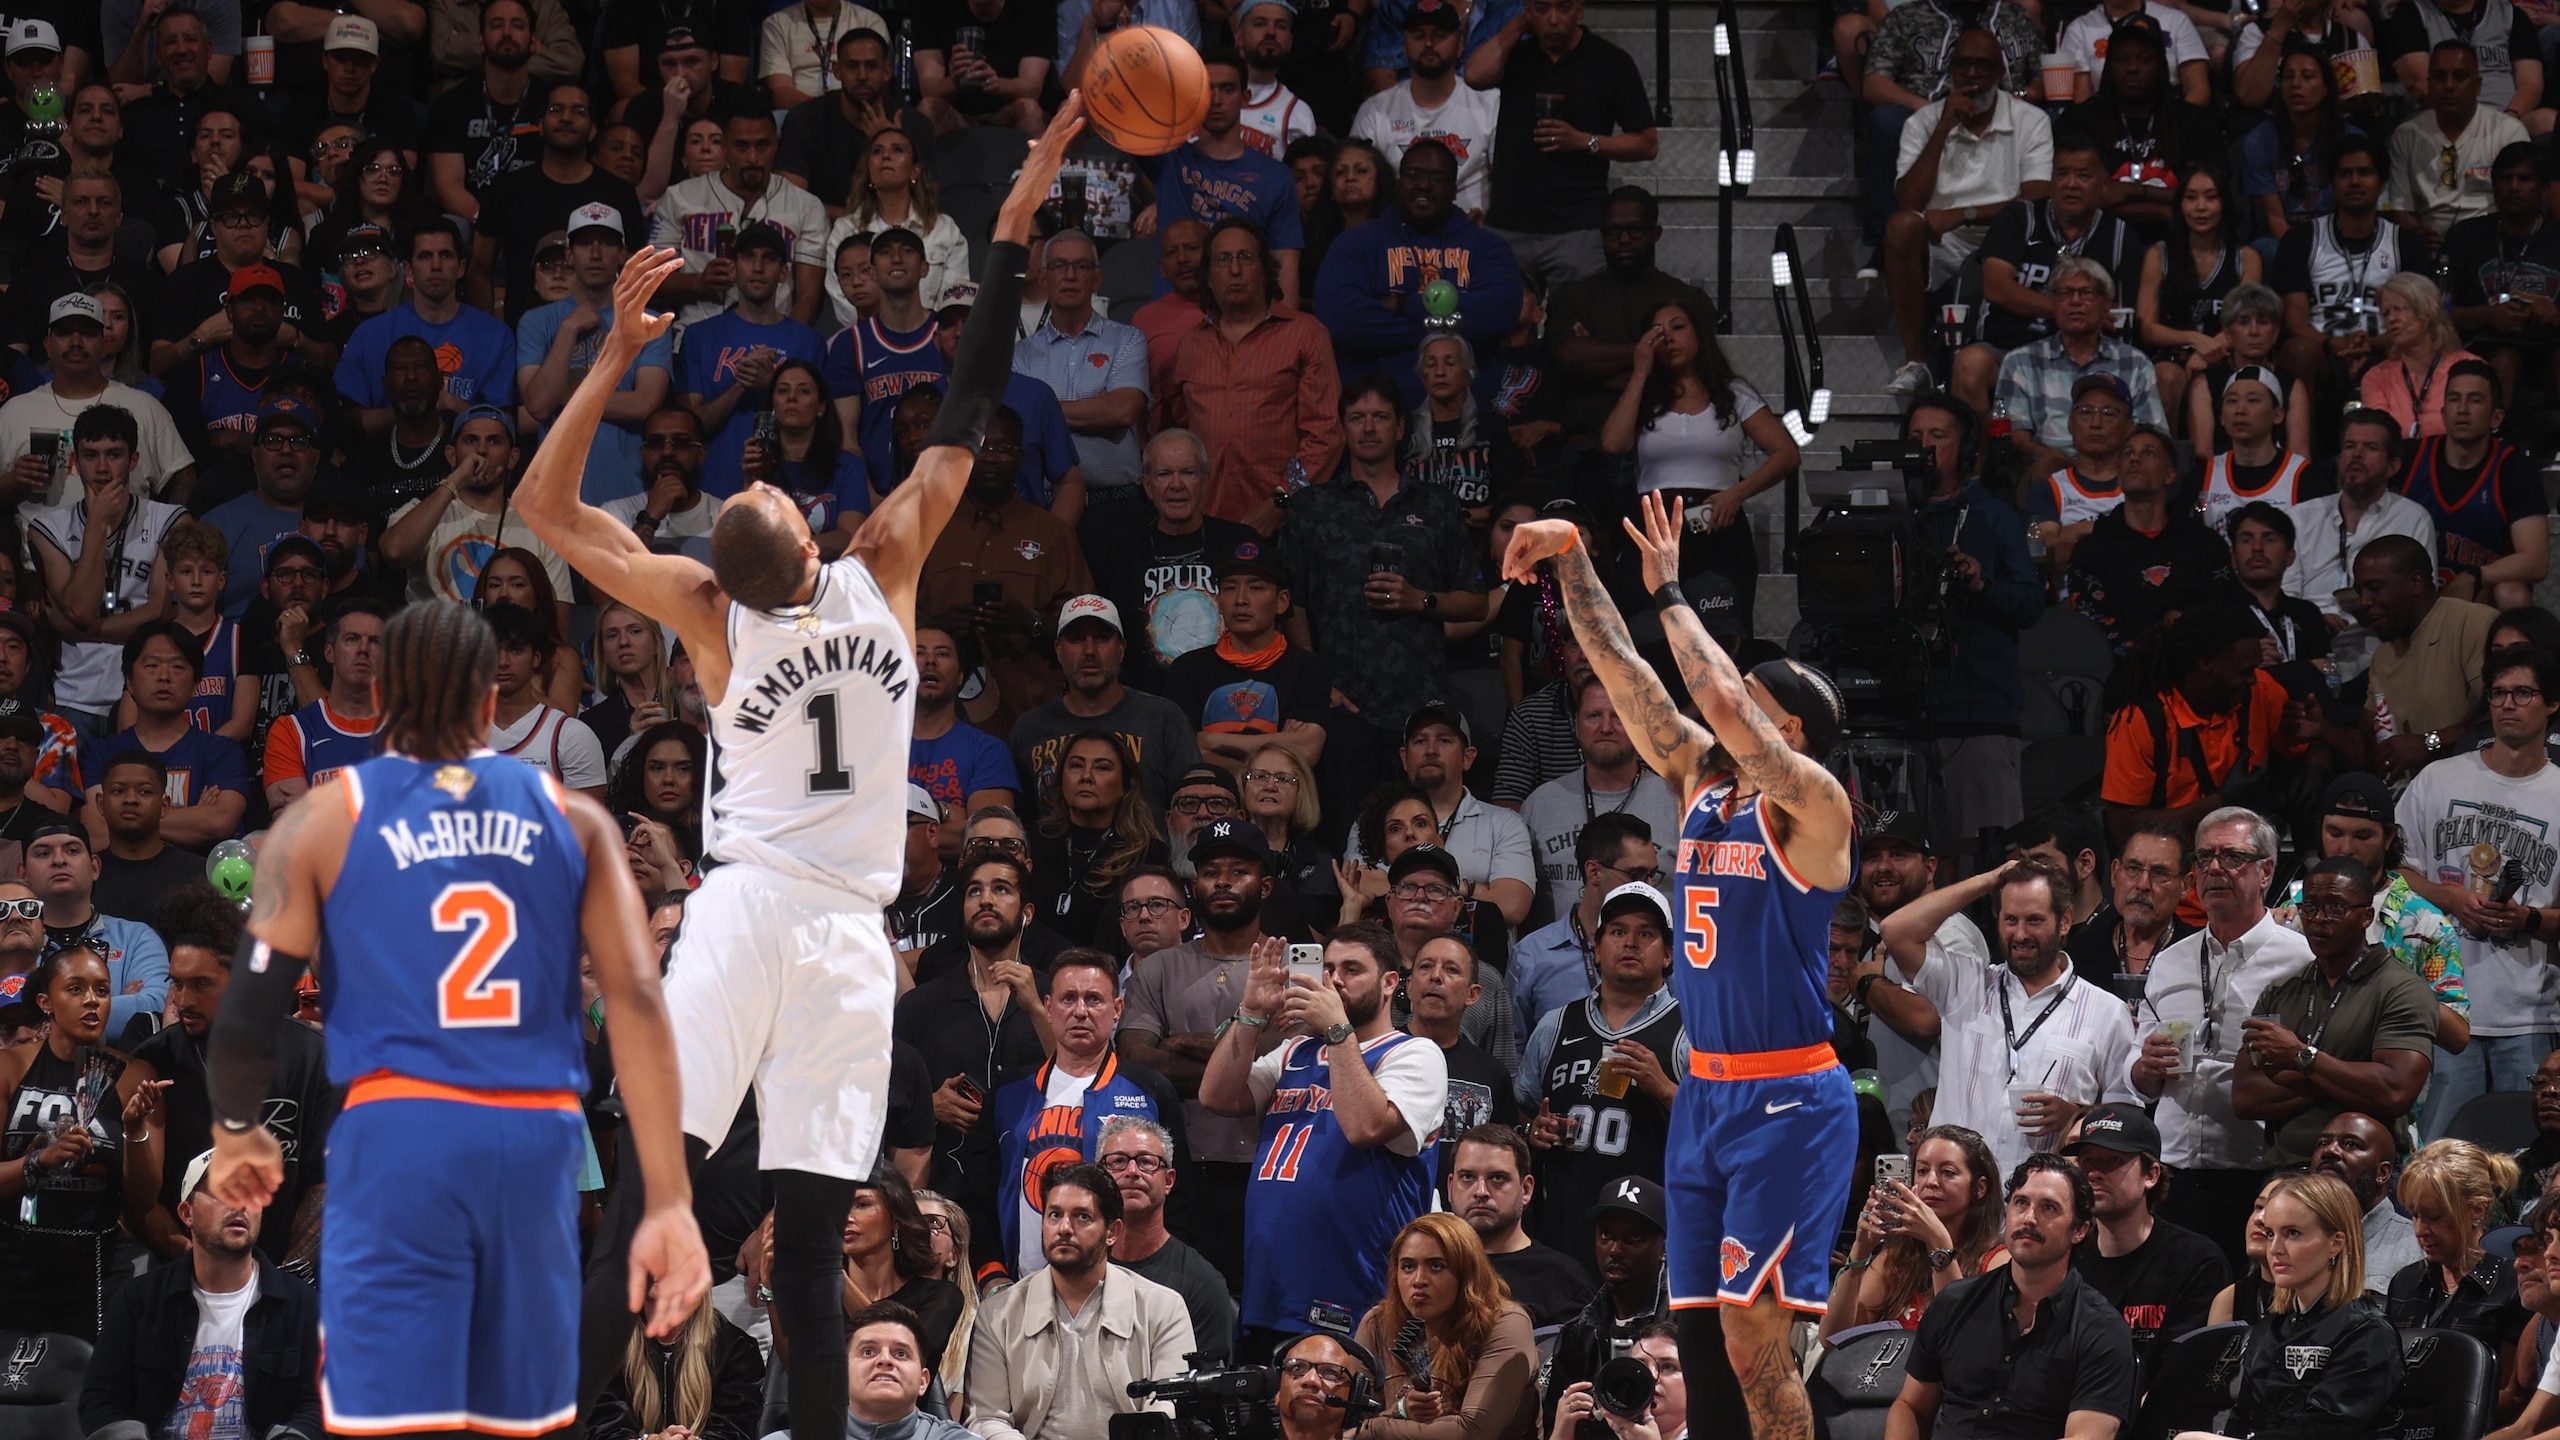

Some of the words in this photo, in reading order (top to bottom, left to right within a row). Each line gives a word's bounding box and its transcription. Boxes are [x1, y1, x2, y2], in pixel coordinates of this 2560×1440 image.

[865, 376, 905, 405] NEW
[1435, 438, 1456, 448] 202
[1143, 565, 1220, 604] SPUR
[734, 635, 909, 735] WEMBANYAMA
[803, 688, 857, 797] 1
[379, 811, 544, 870] McBRIDE
[1213, 821, 1232, 838] NY
[1696, 841, 1767, 881] YORK
[2434, 814, 2558, 887] CHAMPIONS
[1684, 886, 1719, 970] 5
[431, 882, 521, 1029] 2
[1113, 1095, 1146, 1104] SQUARE
[1115, 1102, 1141, 1110] SPACE
[1266, 1088, 1309, 1115] NEW
[1566, 1103, 1633, 1158] 00
[1258, 1122, 1314, 1182] 11
[2123, 1305, 2167, 1329] SPURS
